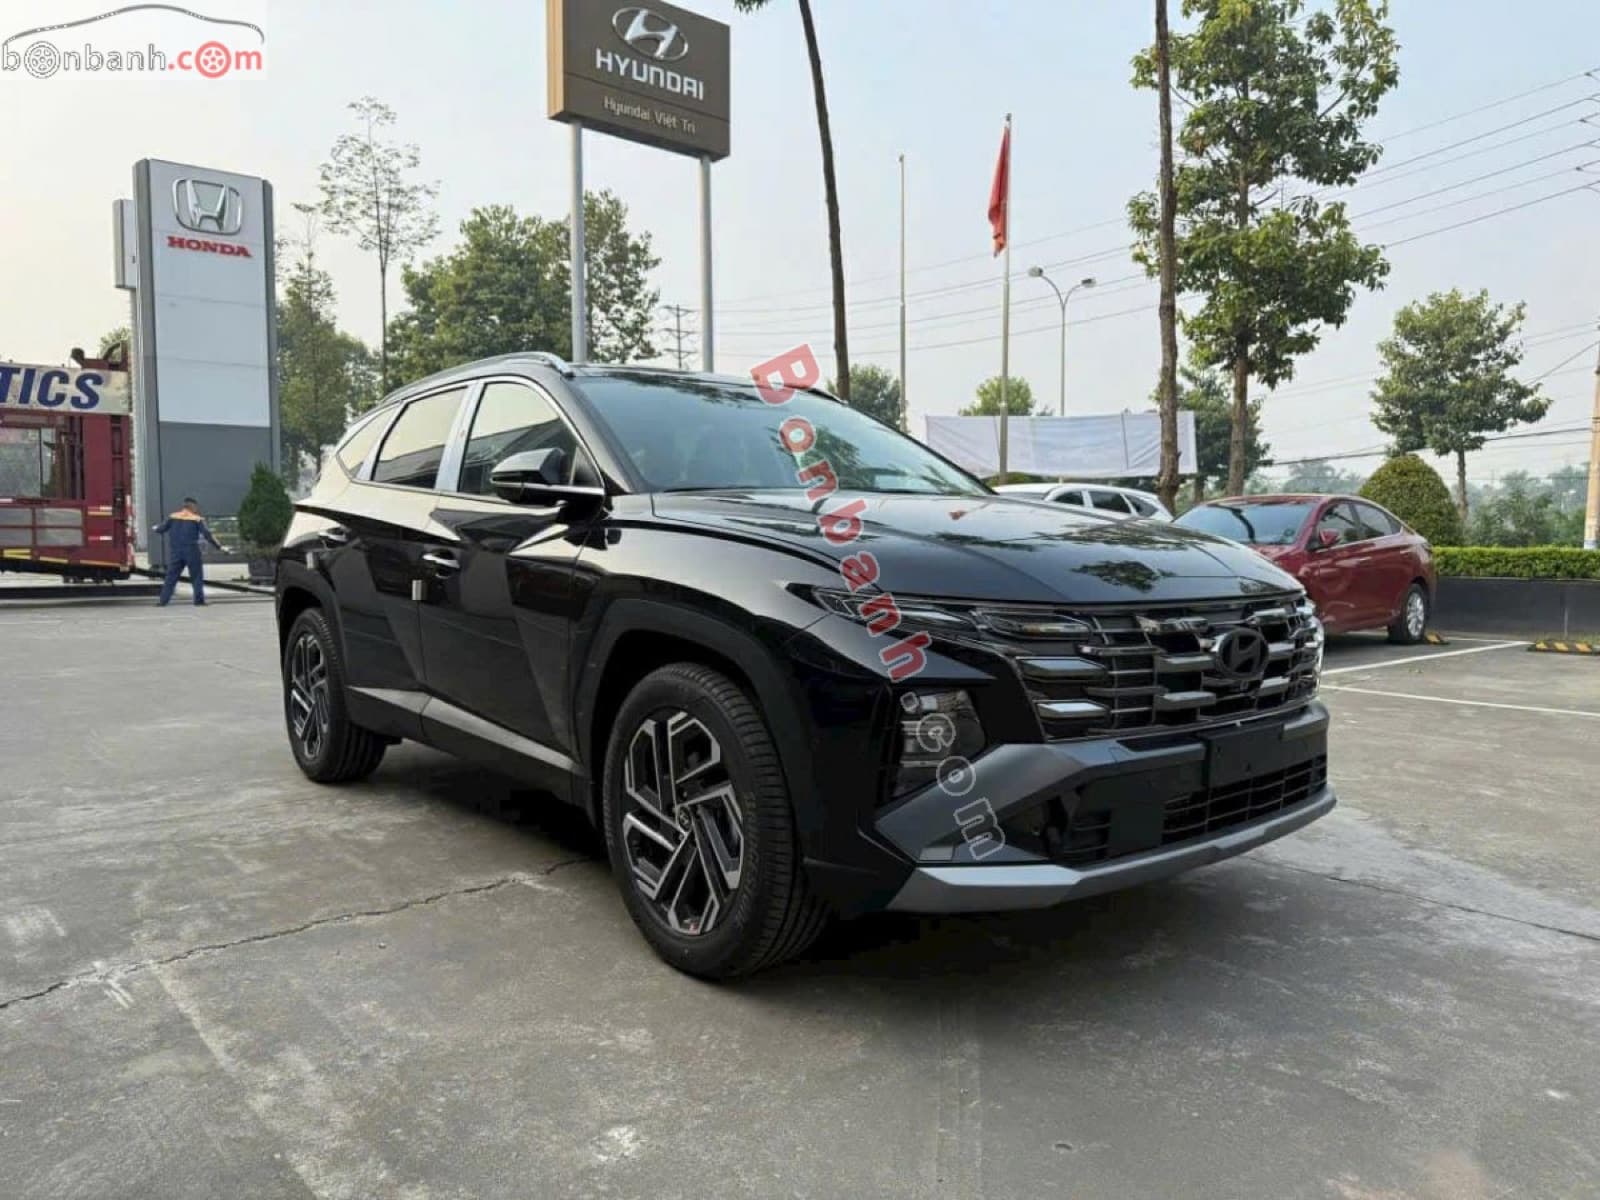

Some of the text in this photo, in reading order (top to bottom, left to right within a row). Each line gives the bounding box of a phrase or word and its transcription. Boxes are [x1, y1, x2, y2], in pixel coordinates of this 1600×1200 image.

[596, 48, 704, 100] HYUNDAI
[604, 96, 650, 120] Hyundai
[167, 236, 252, 257] HONDA
[0, 366, 104, 410] TICS
